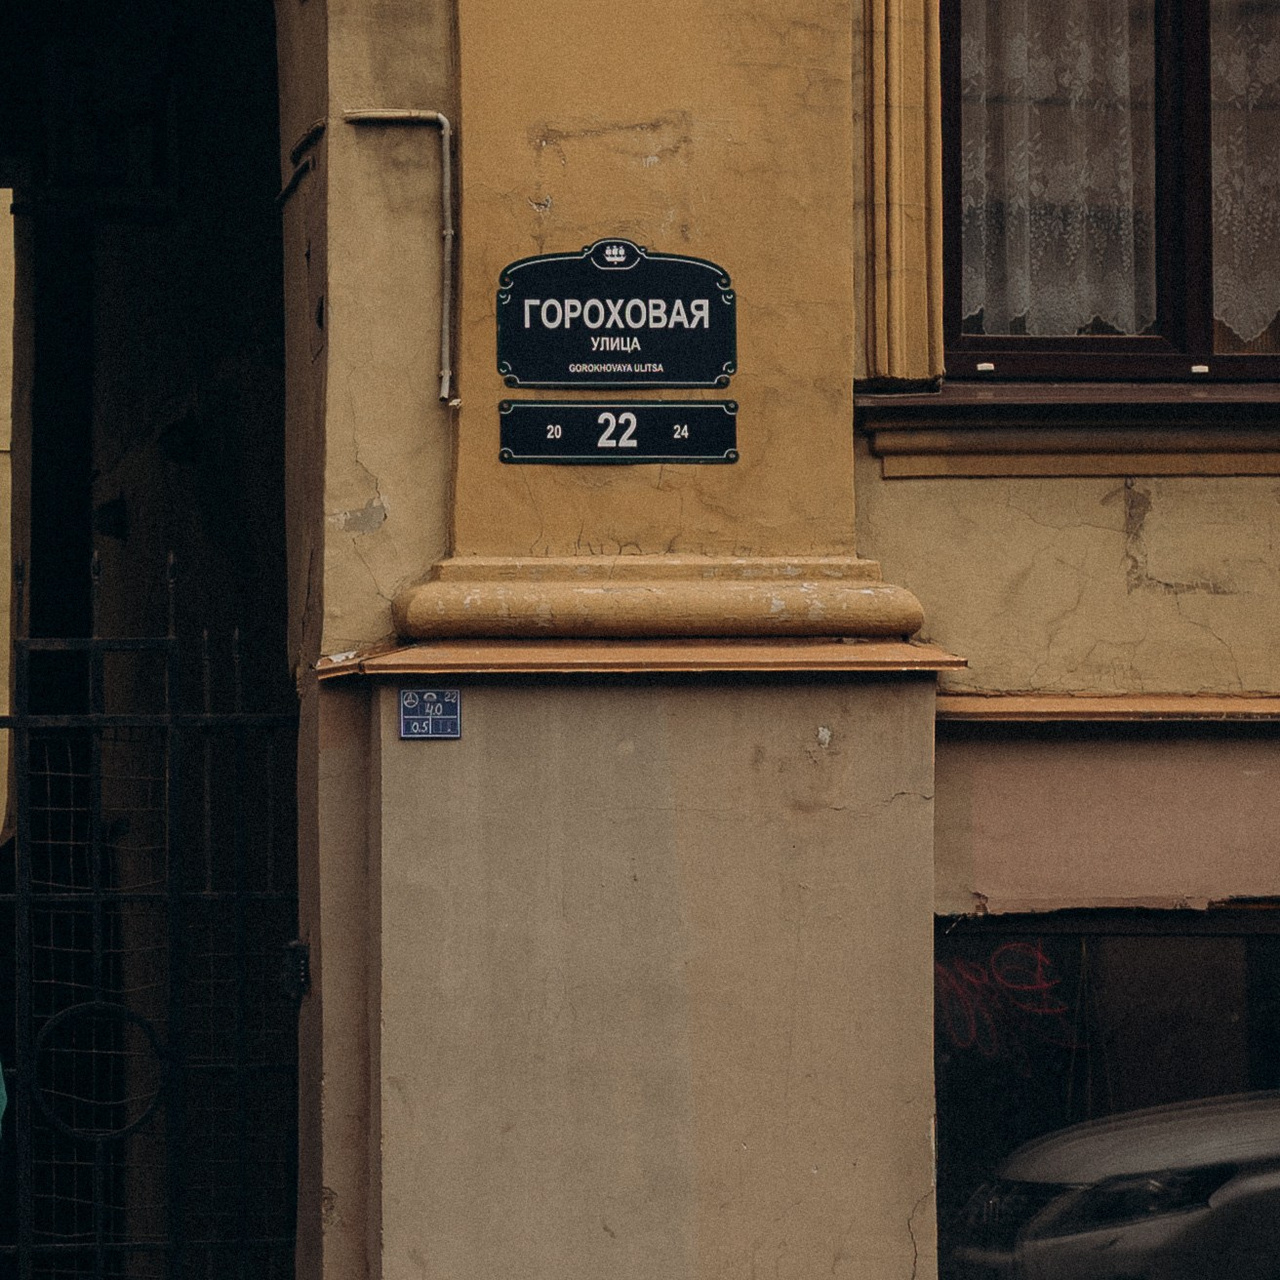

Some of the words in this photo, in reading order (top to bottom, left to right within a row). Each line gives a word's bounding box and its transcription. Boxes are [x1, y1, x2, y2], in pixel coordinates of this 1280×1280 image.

[524, 299, 710, 329] ГОРОХОВАЯ
[591, 337, 641, 353] УЛИЦА
[569, 363, 633, 373] GOROKHOVAYA
[634, 363, 664, 373] ULITSA
[546, 425, 562, 439] 20
[597, 412, 638, 448] 22
[673, 425, 689, 439] 24
